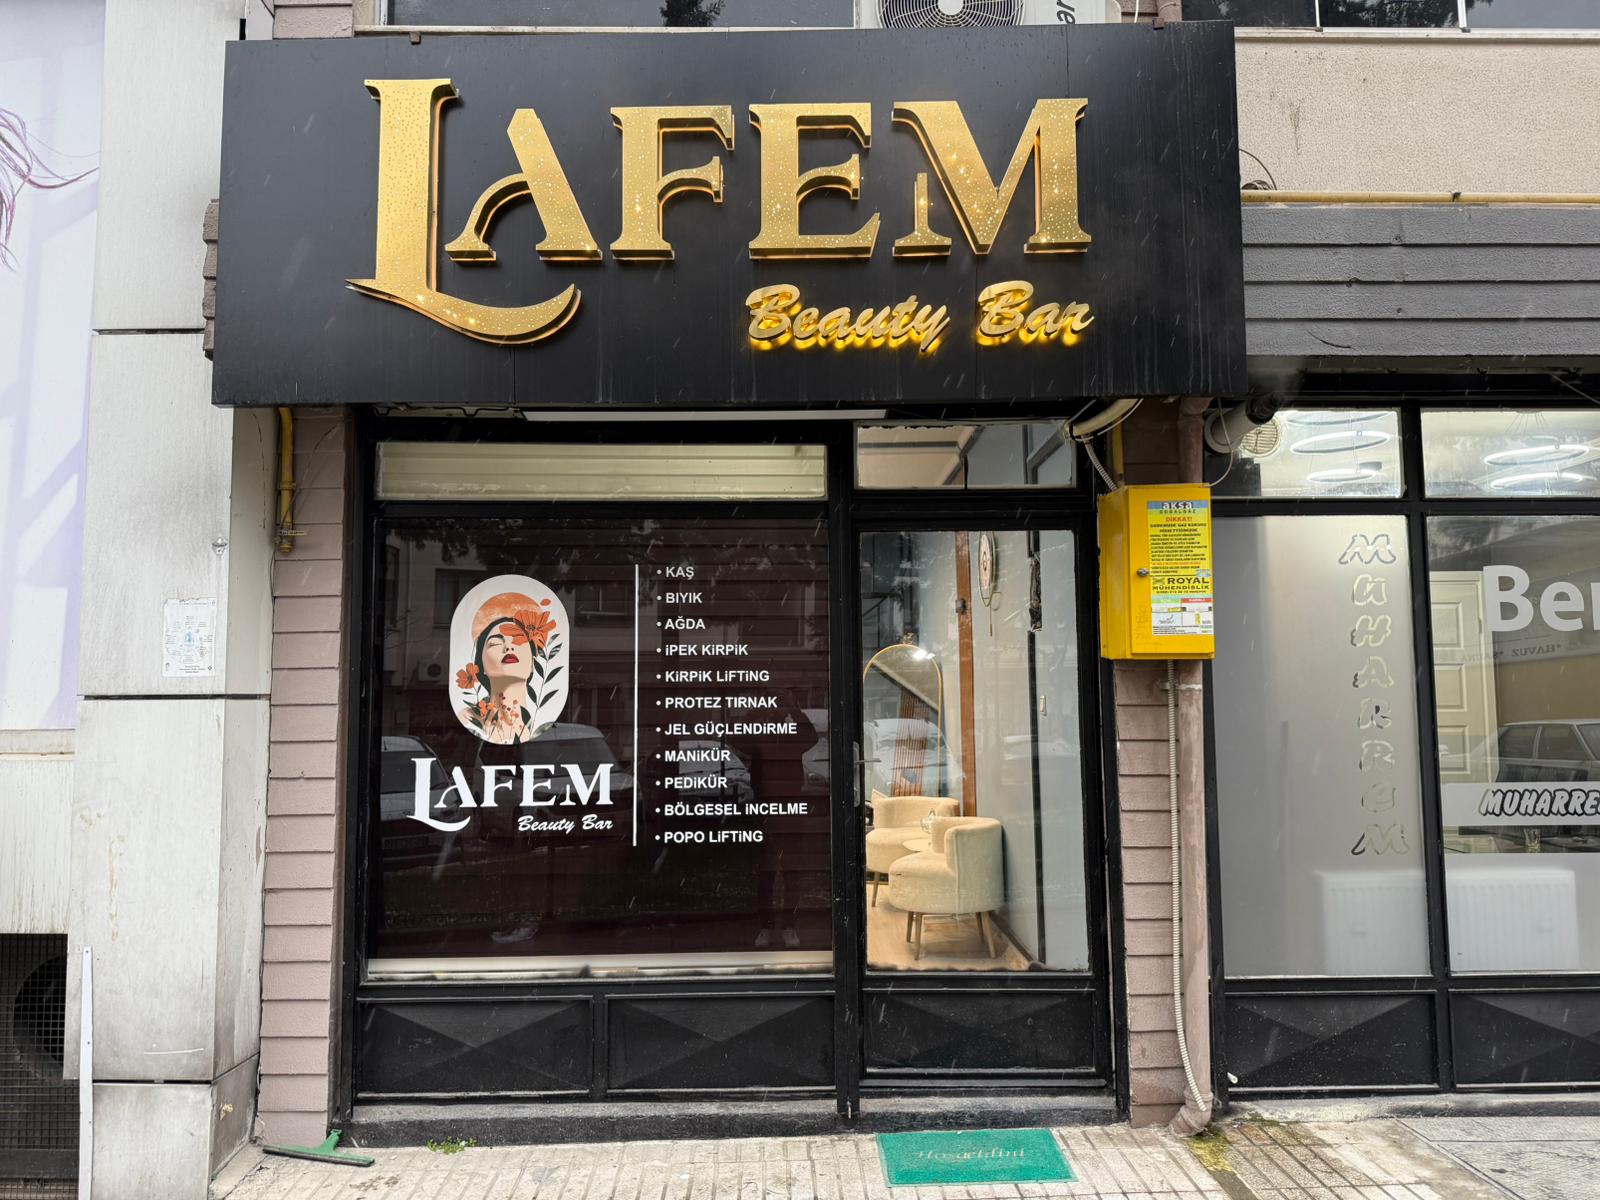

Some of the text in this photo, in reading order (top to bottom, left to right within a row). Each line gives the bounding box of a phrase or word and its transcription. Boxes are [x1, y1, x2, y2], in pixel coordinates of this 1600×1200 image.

[346, 77, 1091, 346] LAFEM
[745, 279, 1095, 353] Beauty Bar
[1162, 501, 1193, 509] aksa
[665, 566, 695, 579] KAŞ
[666, 592, 702, 604] BIYIK
[664, 615, 706, 630] AĞDA
[665, 696, 778, 709] PROTEZ TIRNAK
[664, 723, 691, 735] JEL
[407, 757, 614, 832] LAFEM
[664, 801, 742, 816] BÖLGESEL
[1479, 788, 1600, 817] MUHARRE
[517, 813, 614, 834] Beauty Bar
[664, 830, 705, 843] POPO
